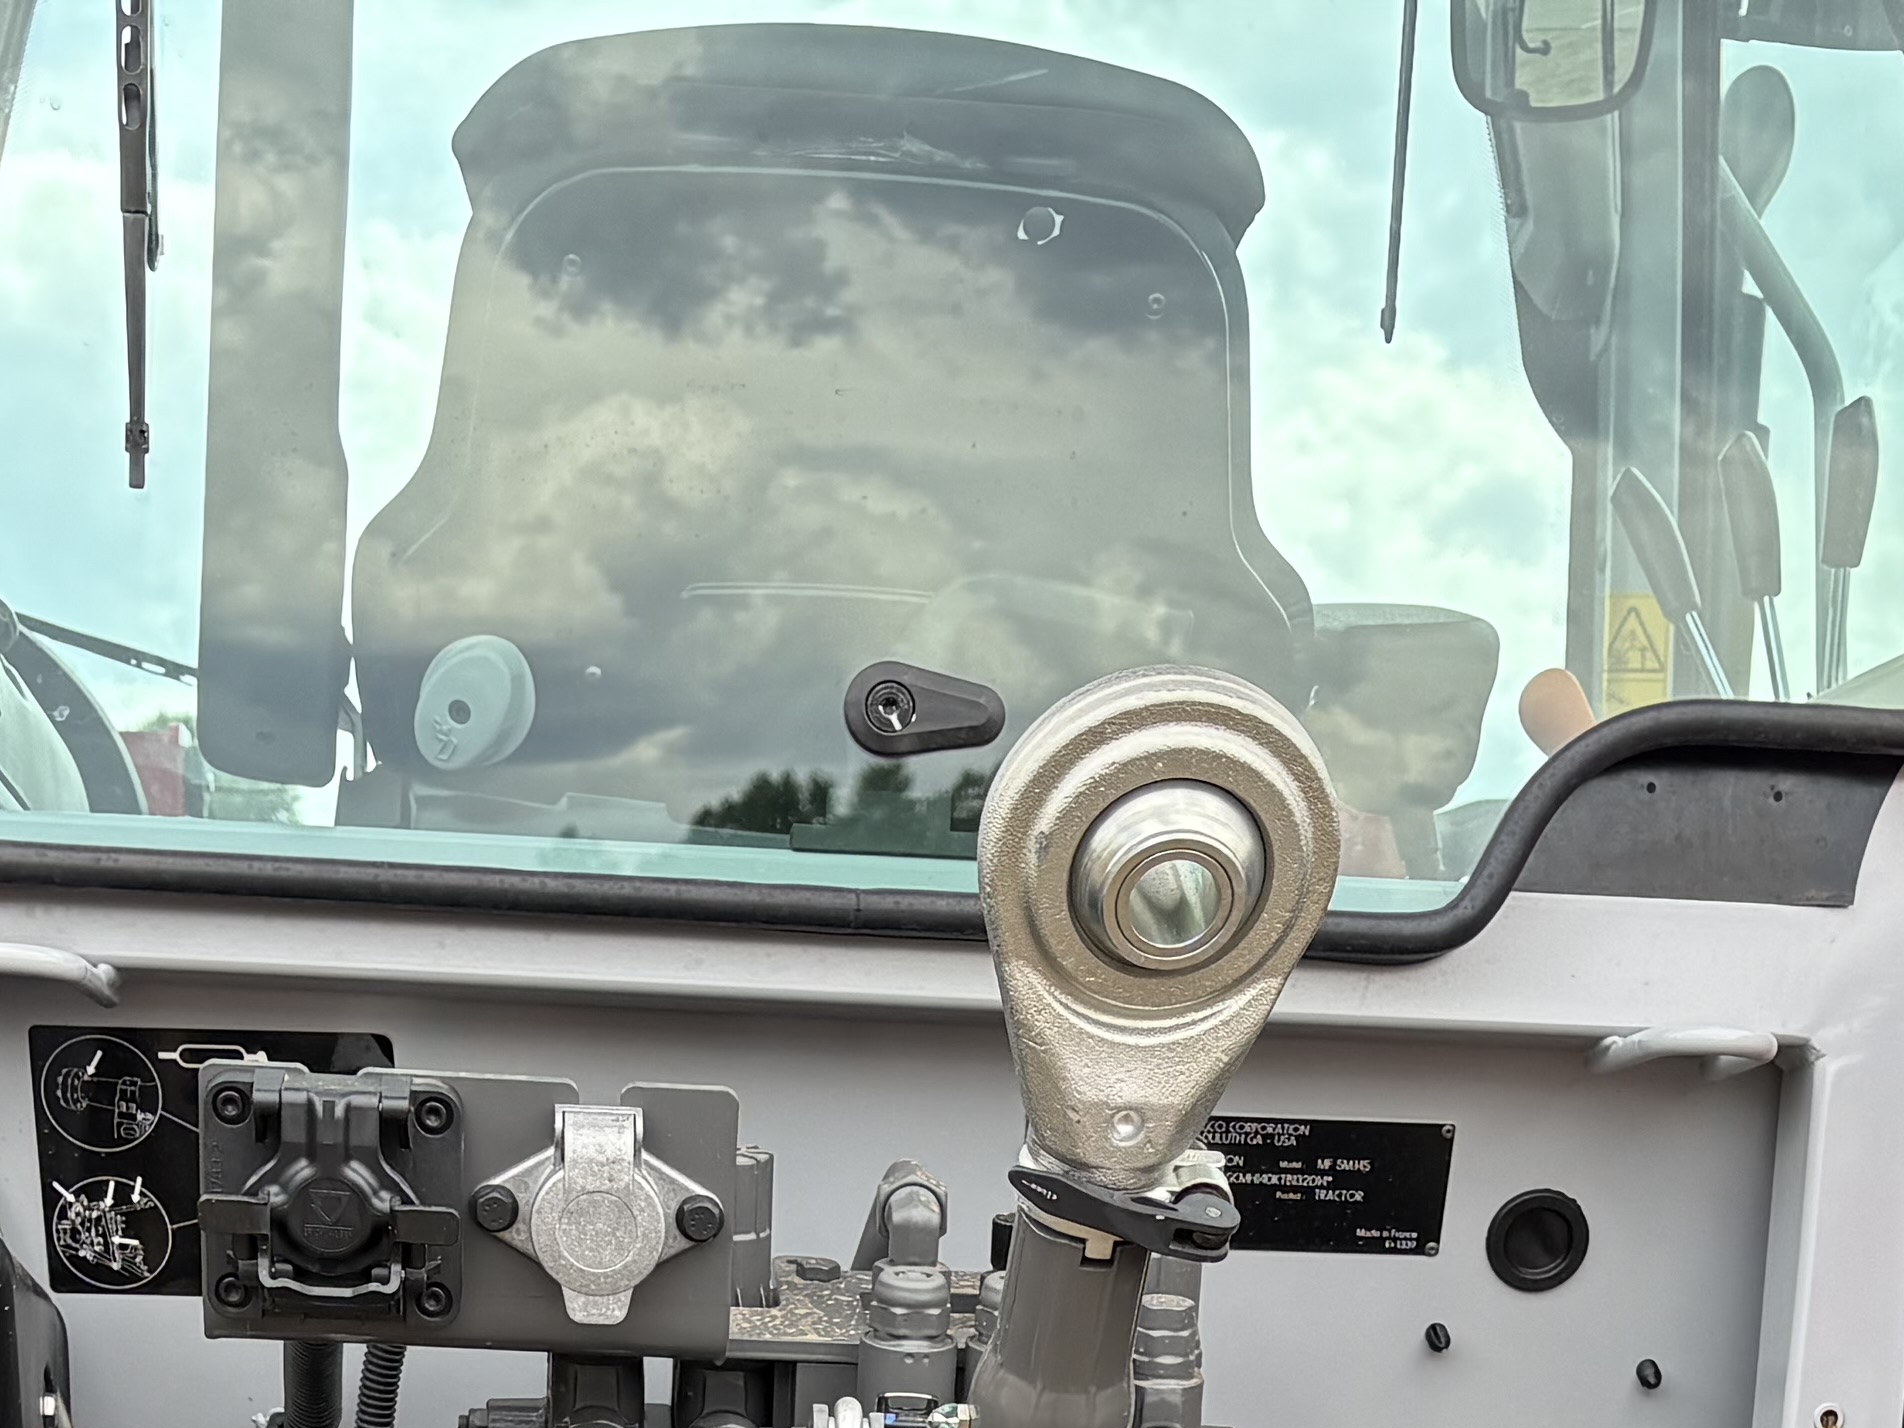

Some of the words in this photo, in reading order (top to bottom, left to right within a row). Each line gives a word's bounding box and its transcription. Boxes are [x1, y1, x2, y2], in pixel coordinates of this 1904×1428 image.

[1229, 1121, 1310, 1136] CORPORATION
[1247, 1134, 1263, 1145] GA
[1274, 1135, 1297, 1147] USA
[1317, 1158, 1333, 1170] MF
[1315, 1189, 1364, 1202] TRACTOR
